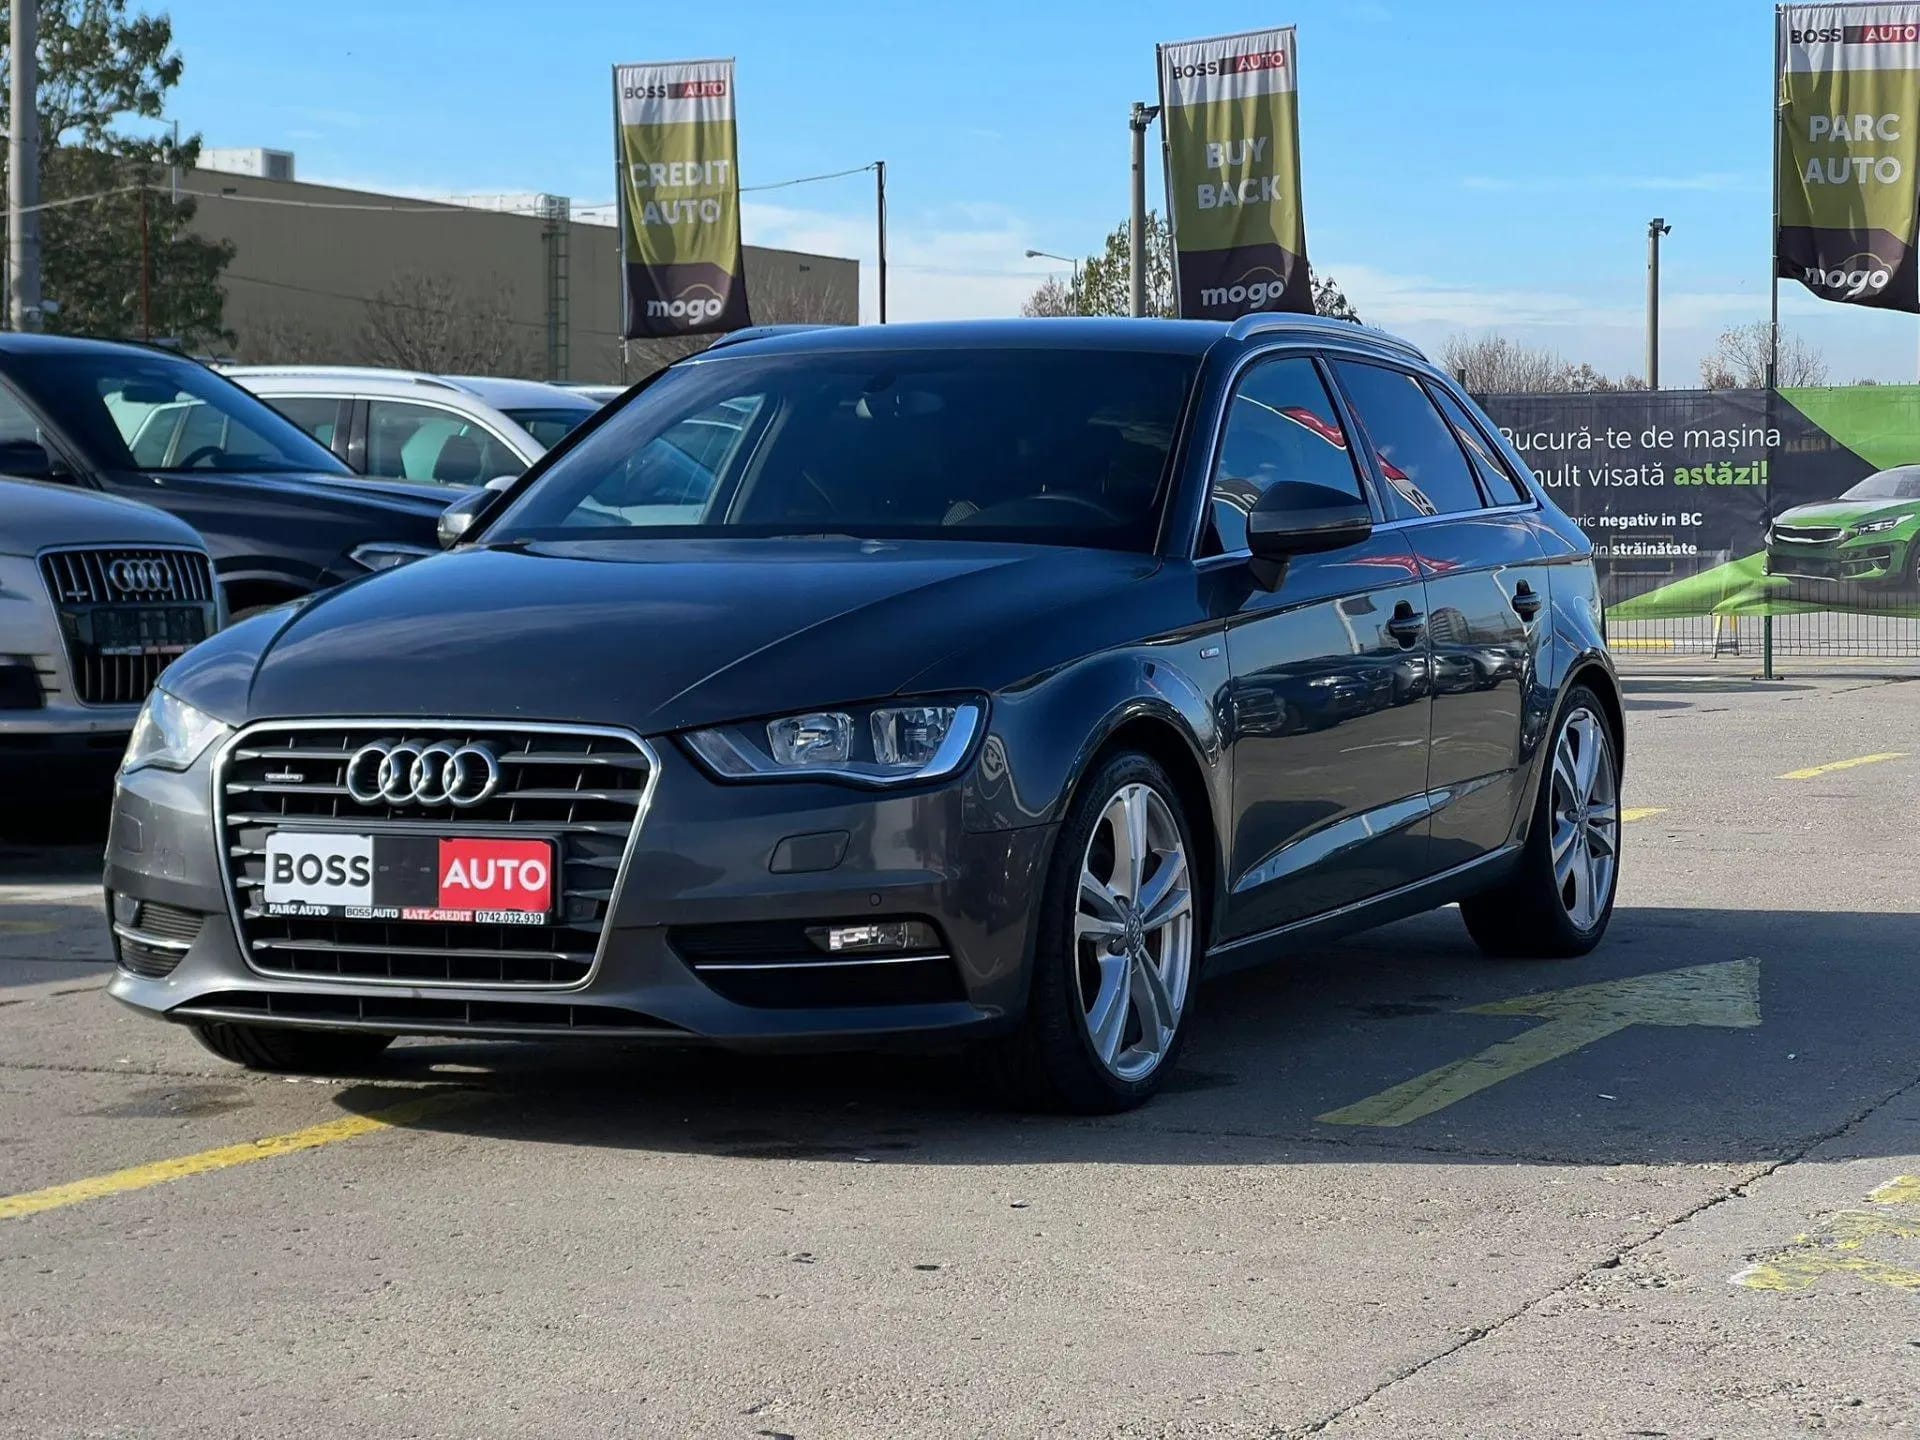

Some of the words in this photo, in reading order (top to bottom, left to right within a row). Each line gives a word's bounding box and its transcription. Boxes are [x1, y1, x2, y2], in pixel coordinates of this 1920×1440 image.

[1790, 28, 1842, 44] BOSS
[1865, 25, 1917, 42] AUTO
[1172, 61, 1218, 80] BOSS
[1238, 53, 1284, 72] AUTO
[624, 84, 666, 100] BOSS
[684, 81, 726, 97] AUTO
[1809, 113, 1900, 142] PARC
[1205, 136, 1268, 169] BUY
[631, 159, 729, 187] CREDIT
[1803, 156, 1901, 185] AUTO
[1197, 175, 1282, 210] BACK
[642, 198, 721, 225] AUTO
[1201, 279, 1285, 309] mogo
[1804, 267, 1889, 300] mogo
[647, 299, 722, 325] mogo
[1640, 425, 1674, 449] de
[1683, 423, 1781, 454] mașina
[1588, 461, 1665, 488] visată
[1673, 459, 1768, 487] astăzi!
[1600, 513, 1657, 530] negativ
[1661, 513, 1676, 526] in
[1681, 512, 1703, 526] BC
[1612, 541, 1698, 556] străinătate
[272, 852, 371, 888] BOSS
[442, 857, 548, 891] AUTO
[268, 903, 297, 915] PARC
[298, 904, 329, 917] AUTO
[346, 908, 371, 918] BOSS
[372, 908, 399, 919] AUTO
[402, 909, 473, 922] RATE-CREDIT
[477, 911, 542, 923] 0742.032.939
